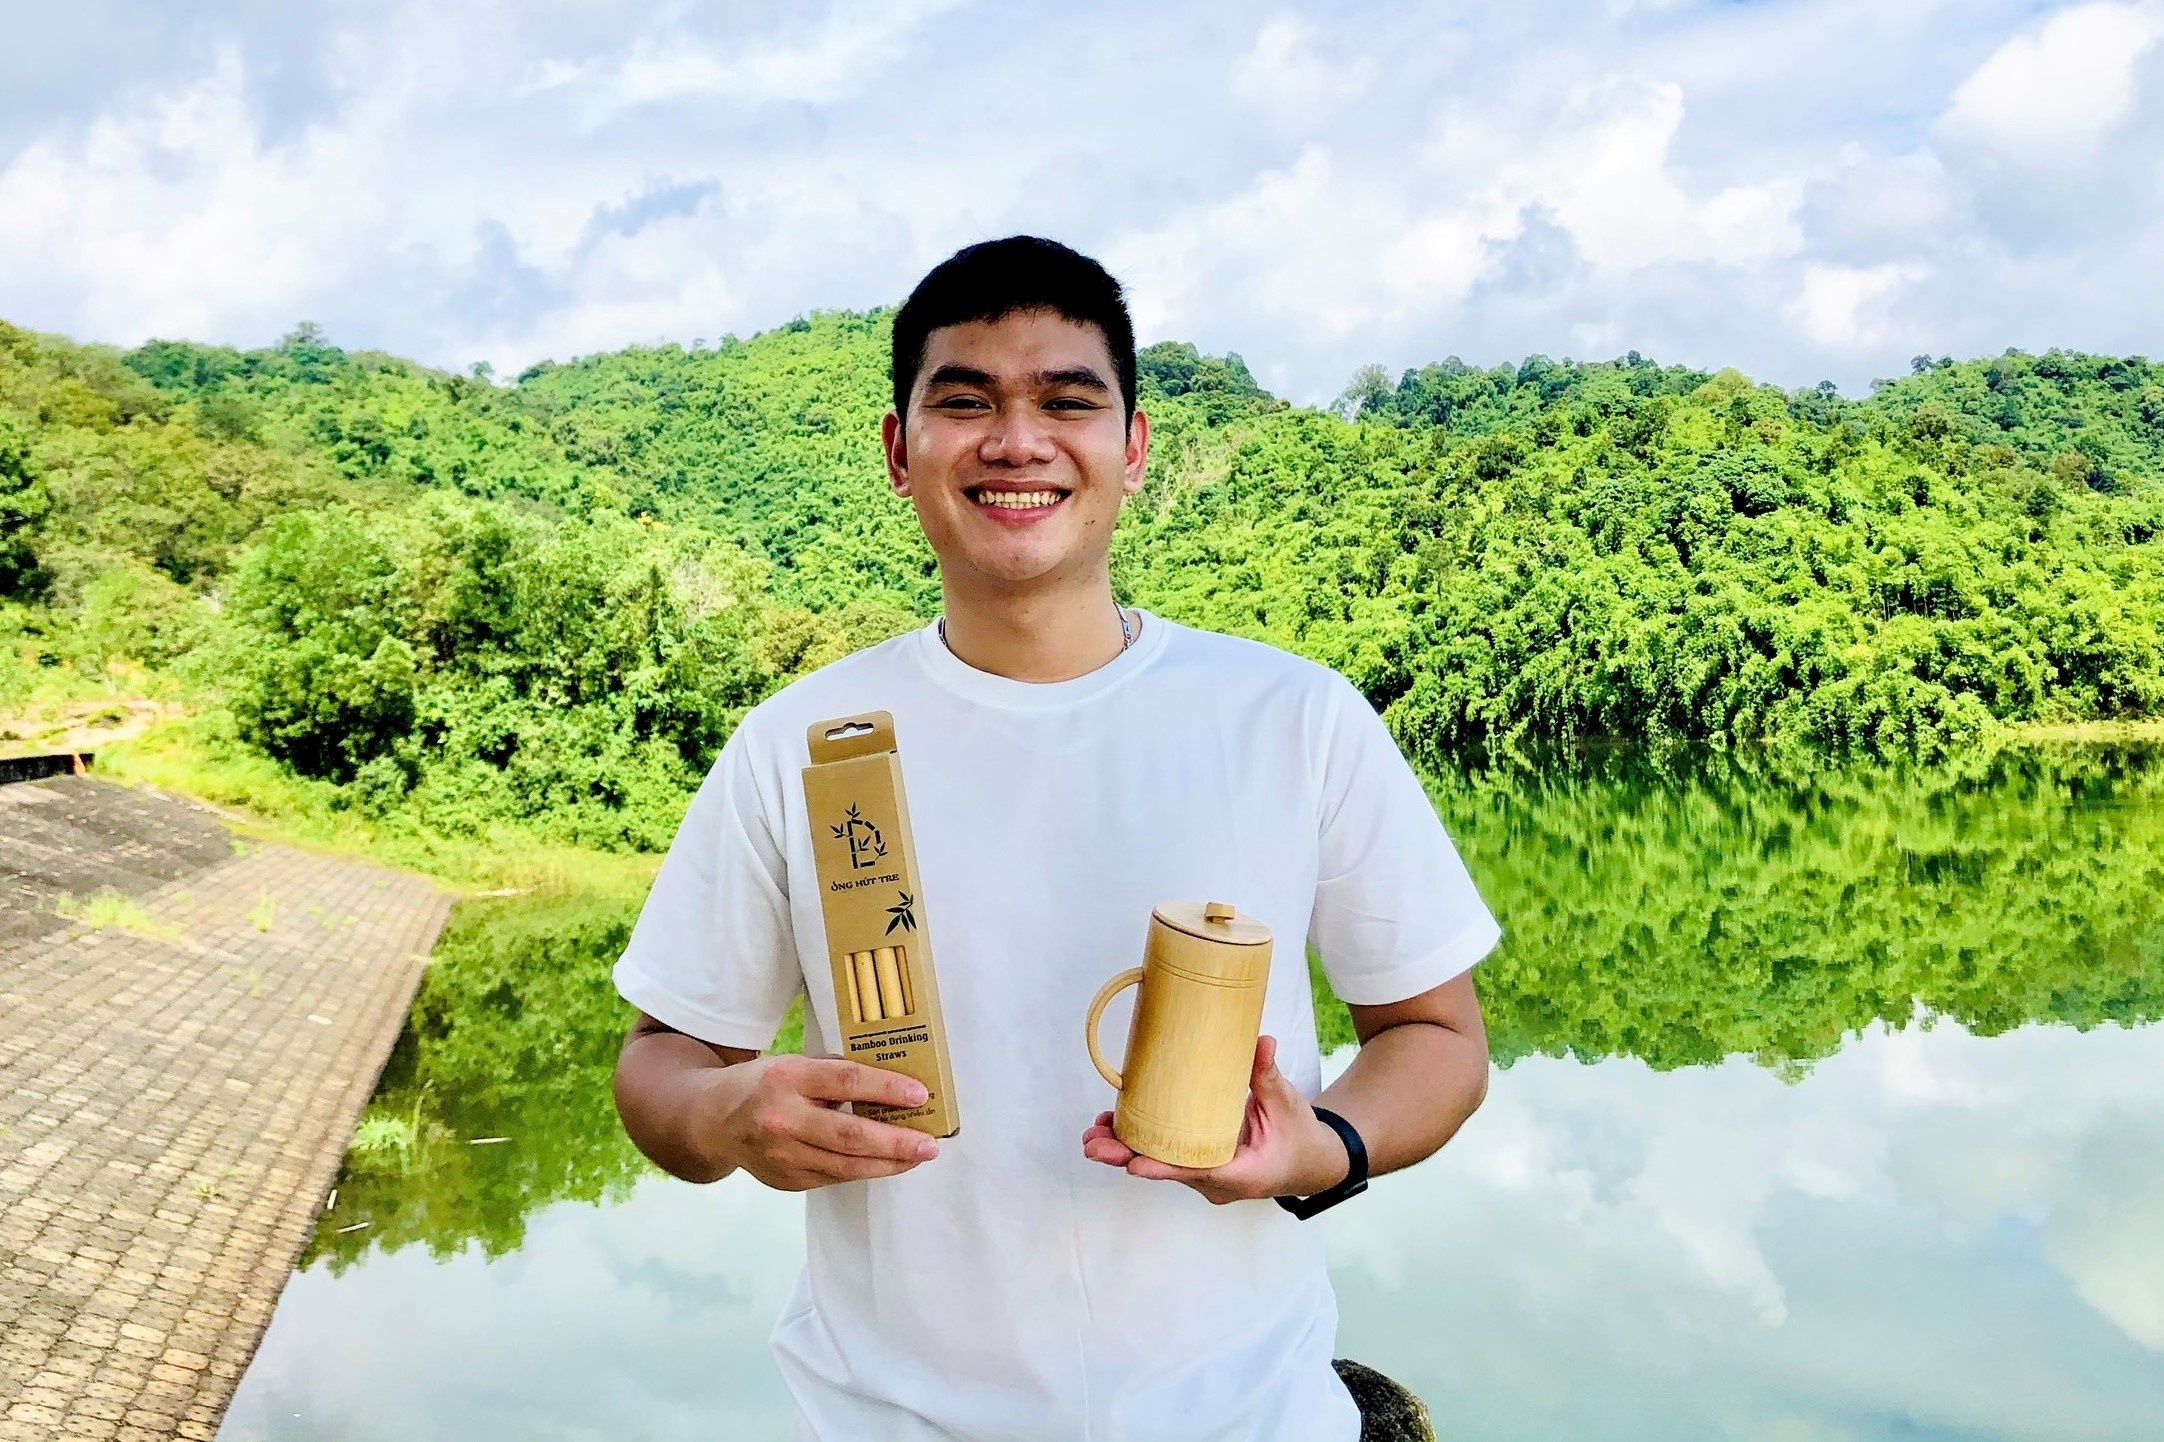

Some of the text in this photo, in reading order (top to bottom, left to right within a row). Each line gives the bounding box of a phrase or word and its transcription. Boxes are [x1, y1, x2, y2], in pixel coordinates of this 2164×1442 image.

[878, 873, 900, 884] TRE
[850, 1033, 929, 1052] Bamboo Drinking
[876, 1050, 907, 1062] Straws
